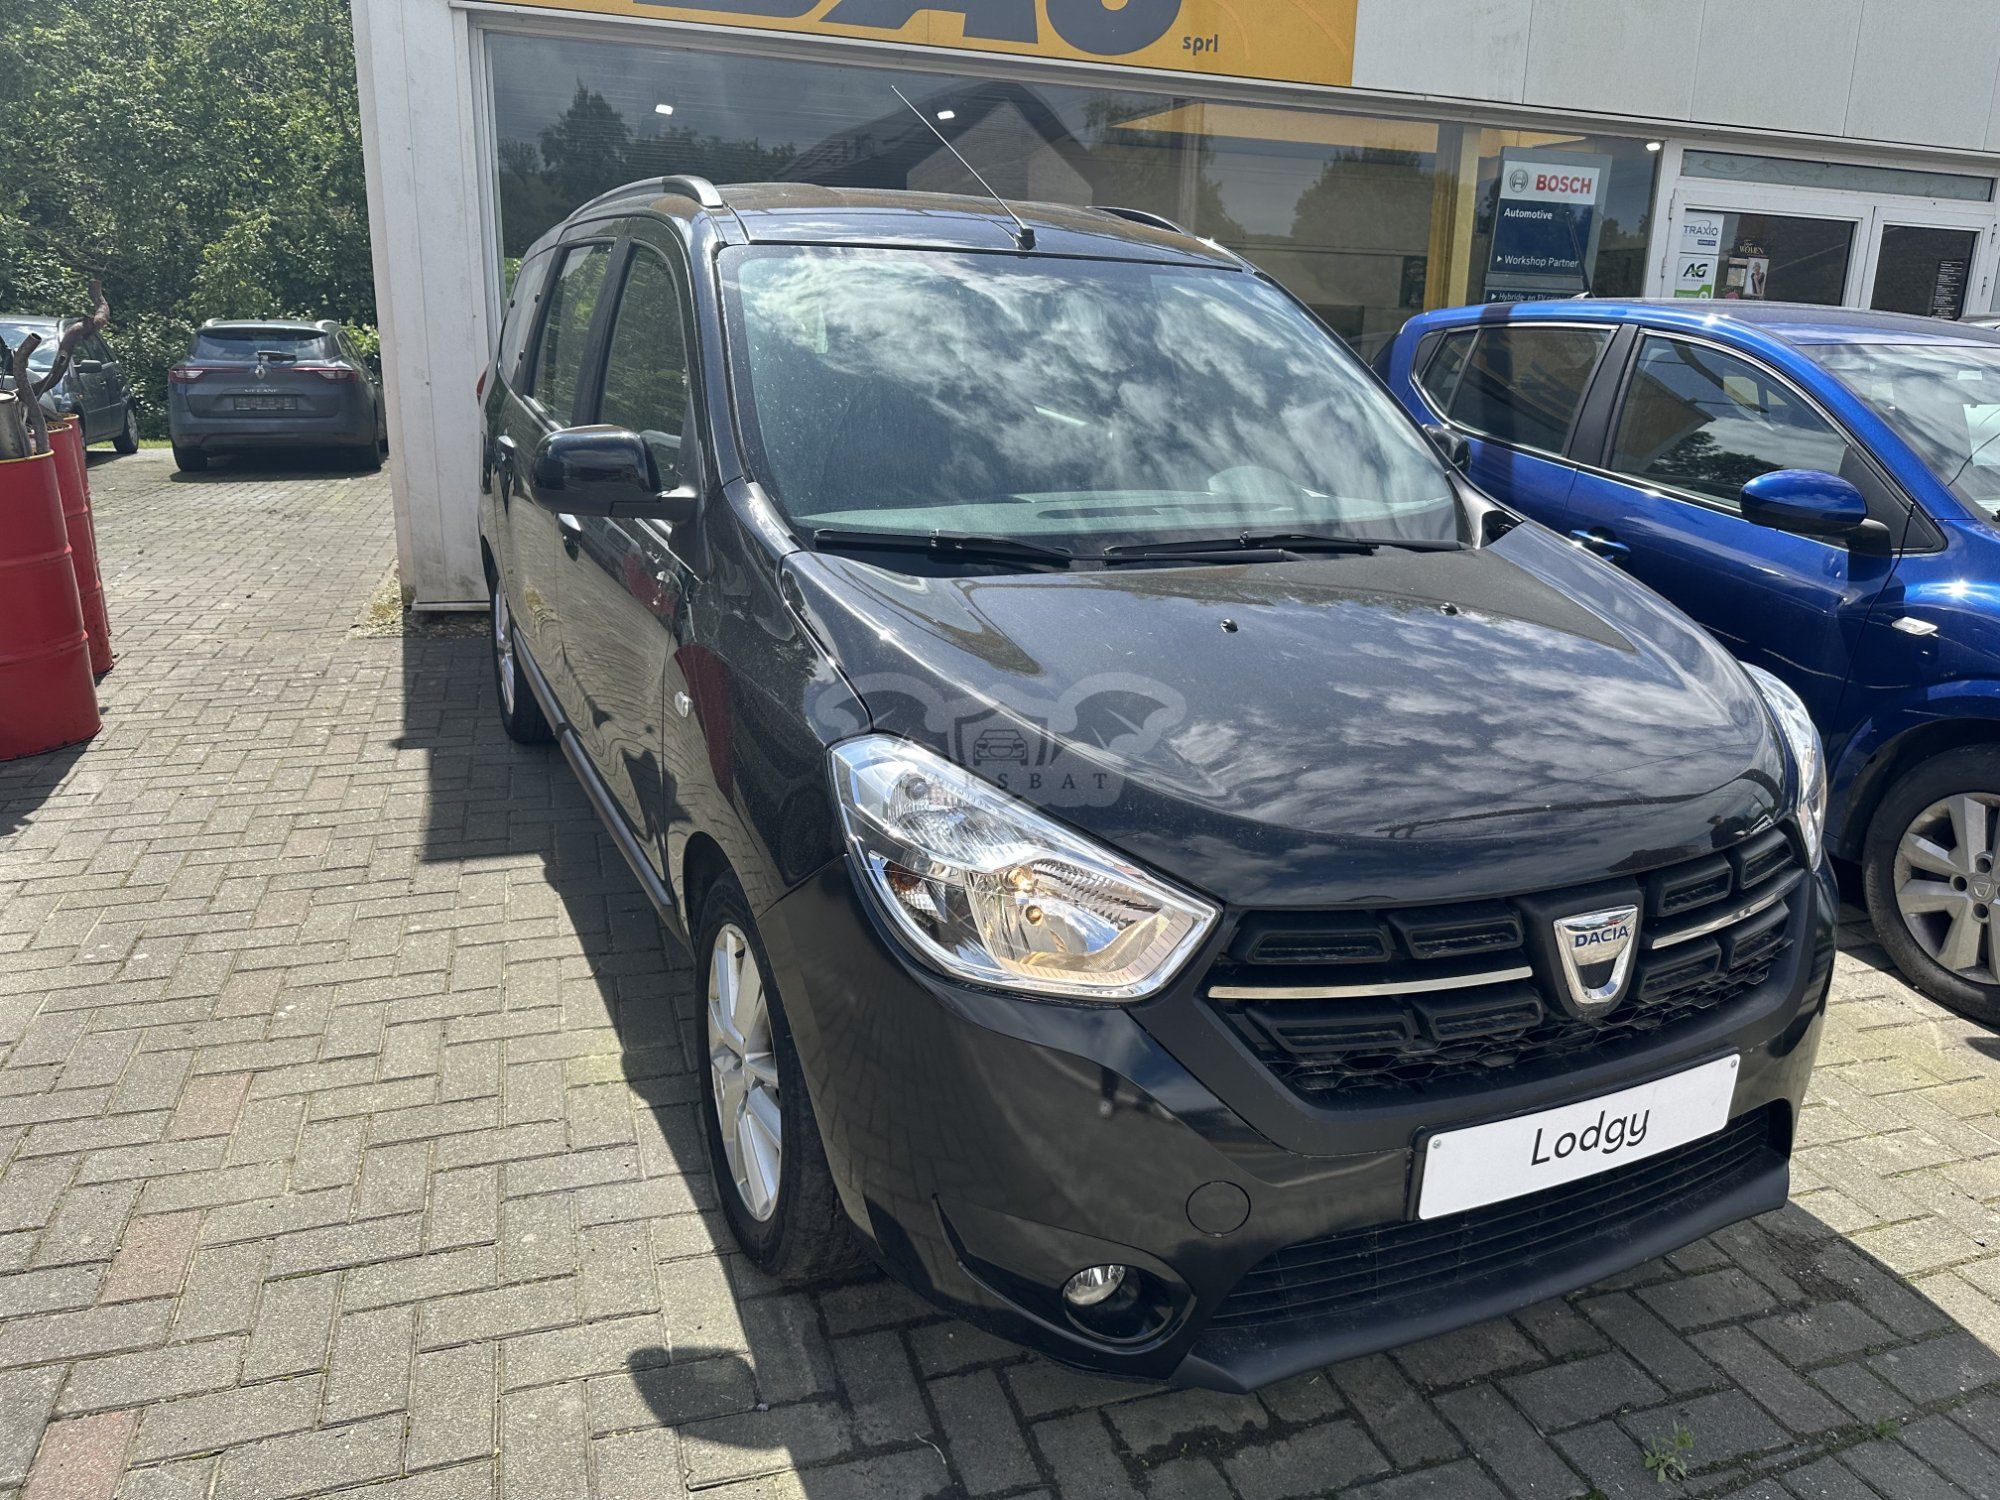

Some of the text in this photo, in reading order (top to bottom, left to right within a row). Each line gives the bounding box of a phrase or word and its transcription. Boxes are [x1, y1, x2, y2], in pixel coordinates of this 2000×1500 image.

[1182, 33, 1219, 56] sprl
[1535, 173, 1592, 194] BOSCH
[1503, 207, 1553, 220] Automotive
[1683, 224, 1718, 236] TRAXIO
[1504, 254, 1580, 268] Workshop Partner
[1682, 263, 1709, 278] AG
[1574, 925, 1629, 948] DACIA
[1531, 1109, 1650, 1167] Lodgy
